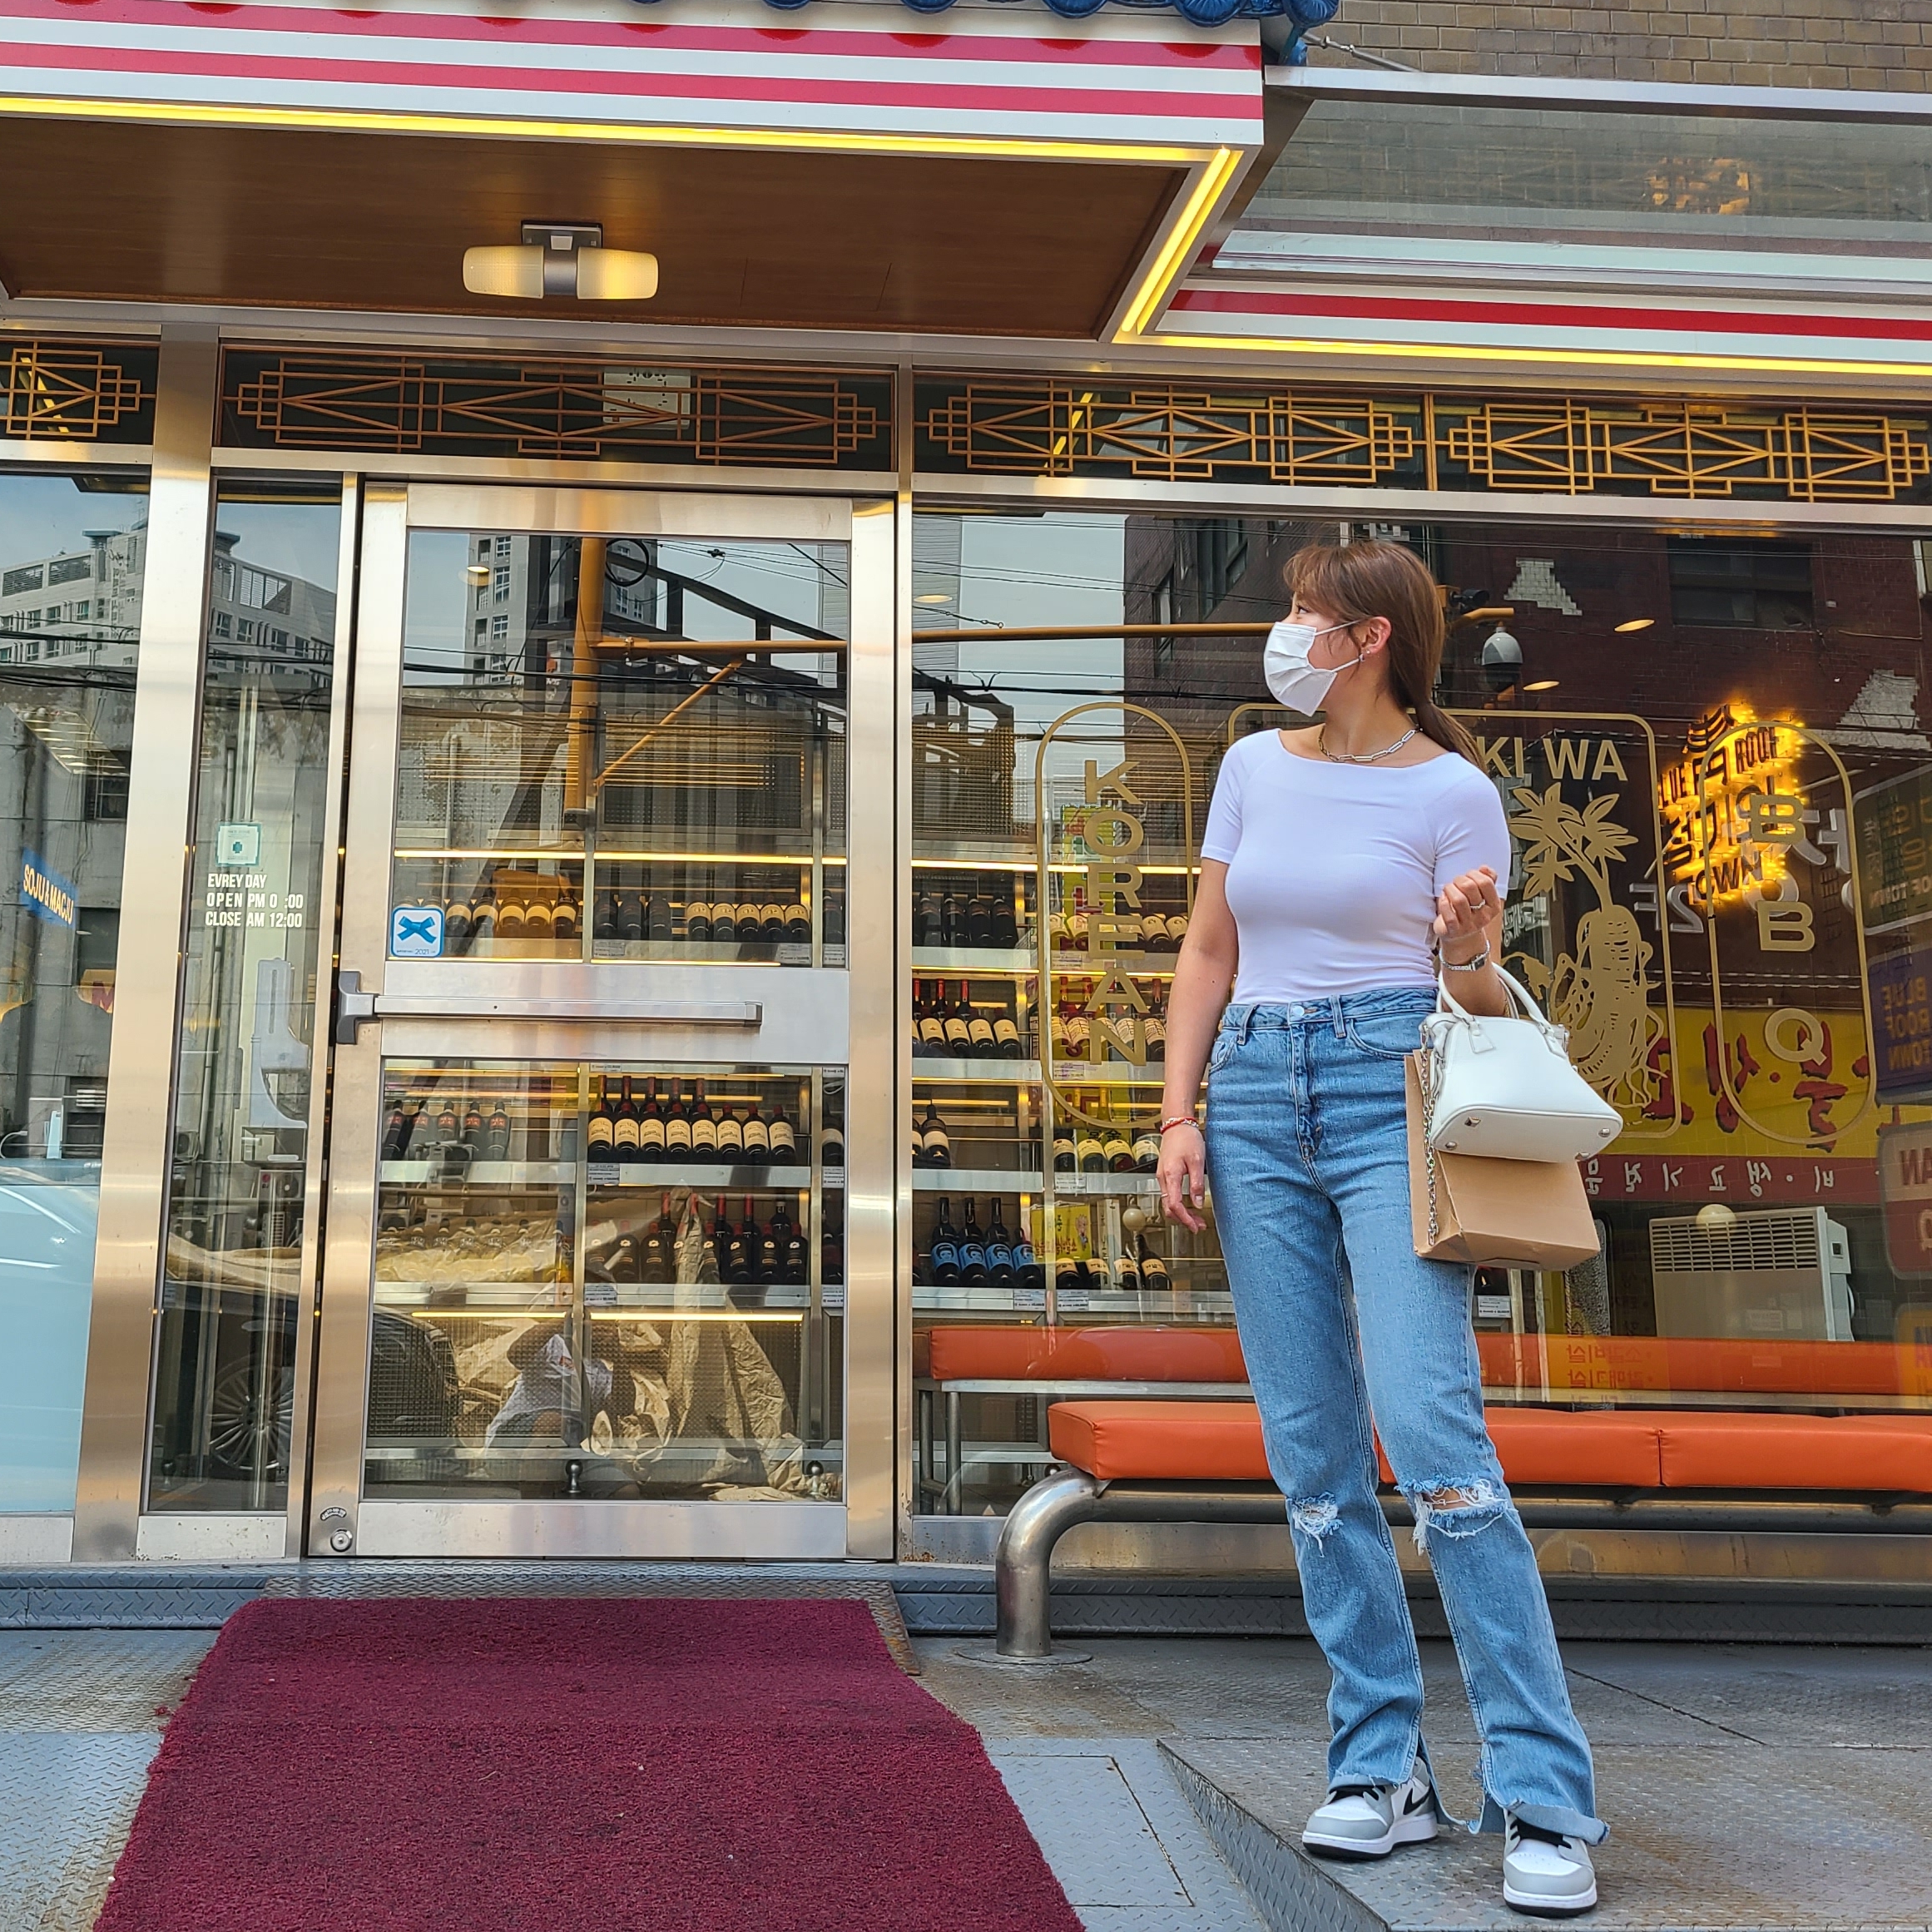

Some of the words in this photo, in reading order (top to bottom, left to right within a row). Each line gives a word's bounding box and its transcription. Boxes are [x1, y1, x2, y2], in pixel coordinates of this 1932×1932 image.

[1476, 736, 1524, 779] KI
[1543, 738, 1628, 781] WA
[207, 873, 244, 888] EVREY
[245, 874, 267, 889] DAY
[206, 892, 243, 908] OPEN
[247, 893, 265, 908] PM
[1083, 760, 1149, 1067] KOREAN
[205, 911, 242, 926] CLOSE
[245, 912, 265, 927] AM
[269, 912, 303, 928] 12:00
[1749, 794, 1827, 1066] BBQ
